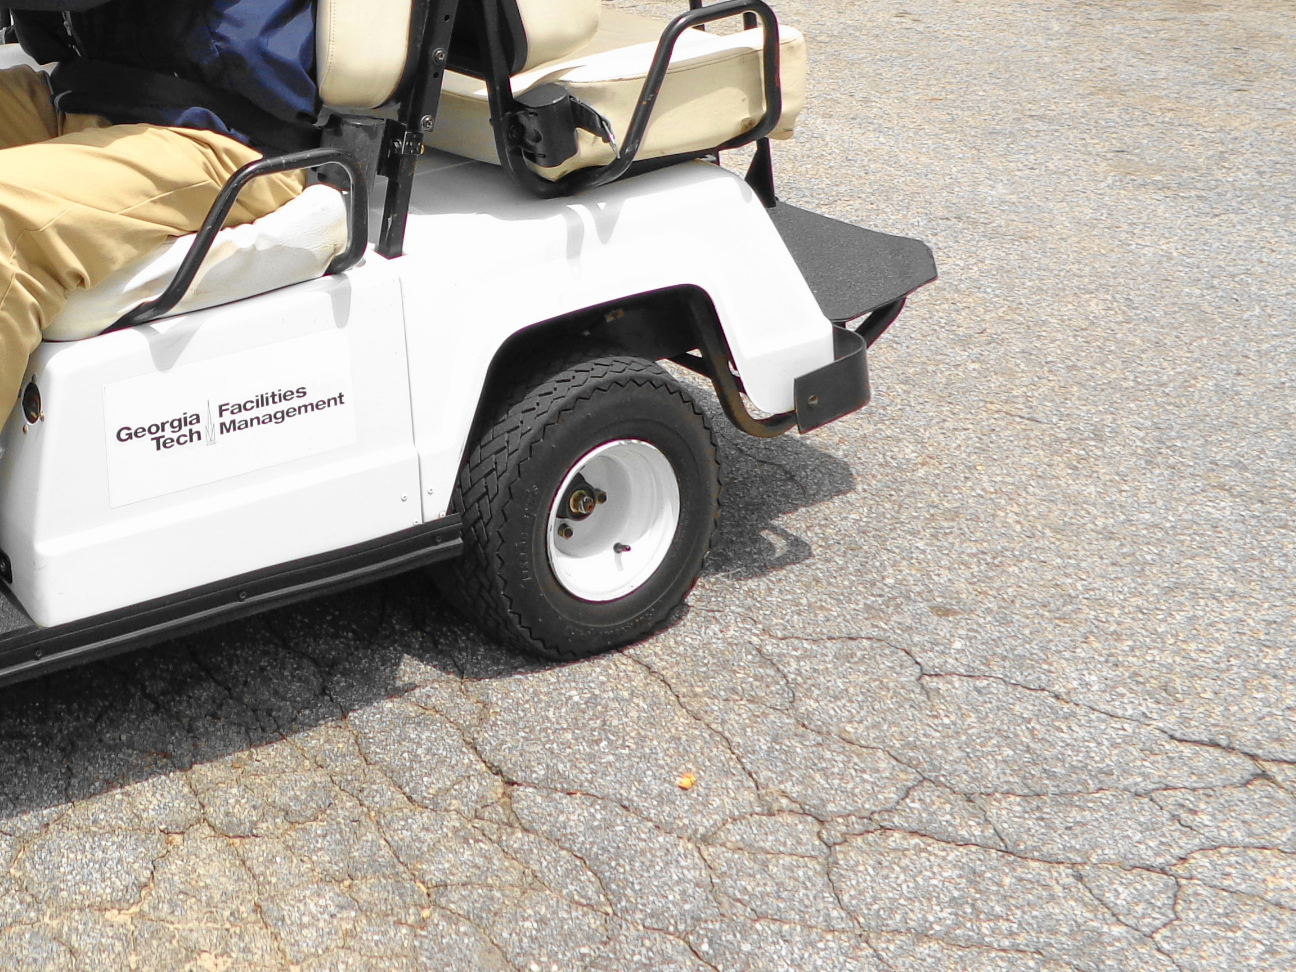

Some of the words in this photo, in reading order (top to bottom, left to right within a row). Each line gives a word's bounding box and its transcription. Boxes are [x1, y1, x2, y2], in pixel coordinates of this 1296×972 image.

[217, 386, 308, 418] Facilities
[219, 392, 345, 435] Management
[115, 412, 202, 443] Georgia
[150, 428, 202, 452] Tech
